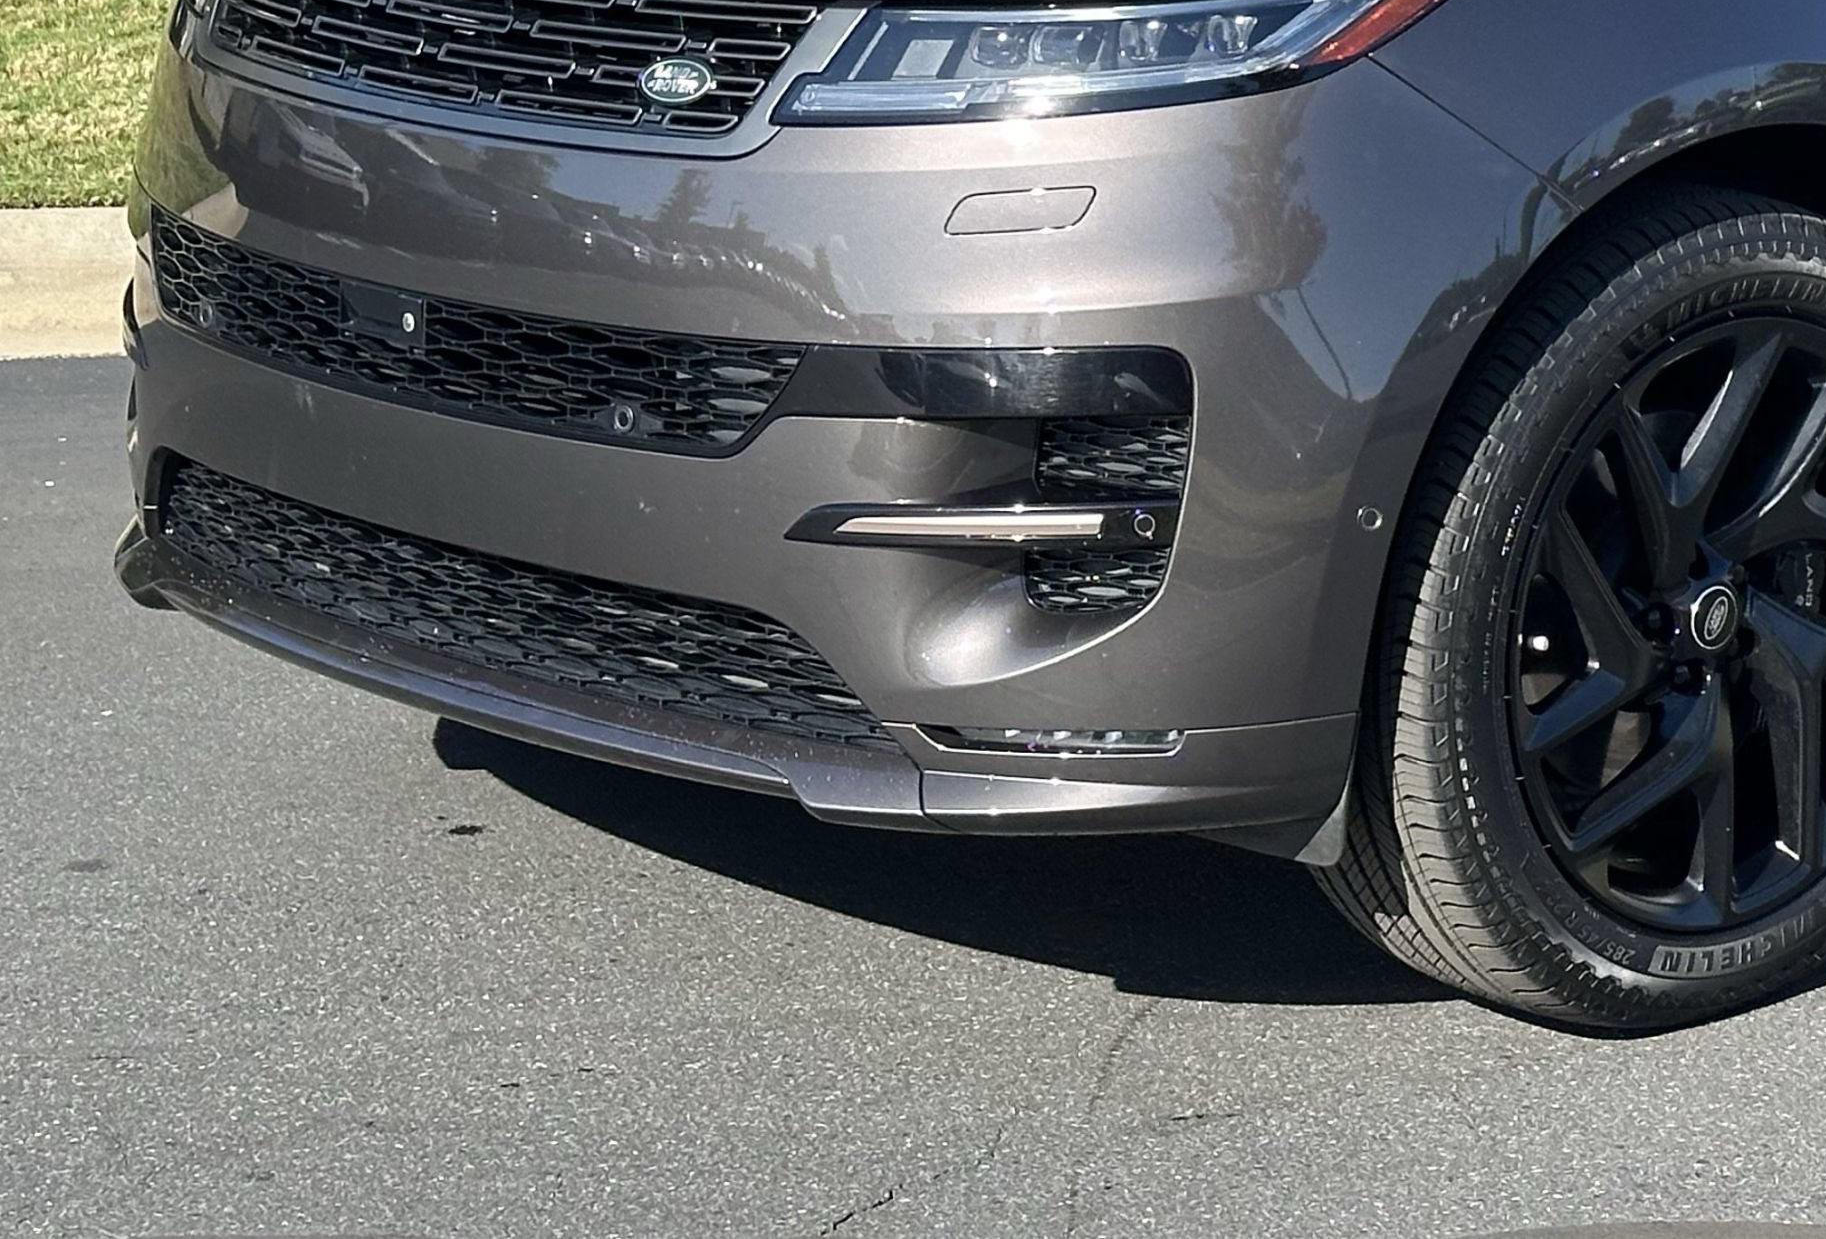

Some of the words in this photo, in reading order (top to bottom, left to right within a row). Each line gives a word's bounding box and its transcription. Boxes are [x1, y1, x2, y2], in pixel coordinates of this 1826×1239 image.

[651, 78, 699, 95] ROVER
[654, 65, 692, 80] LAND
[1675, 278, 1823, 324] MICHELIN
[1804, 552, 1814, 607] LAND
[1660, 908, 1816, 973] MICHELIN
